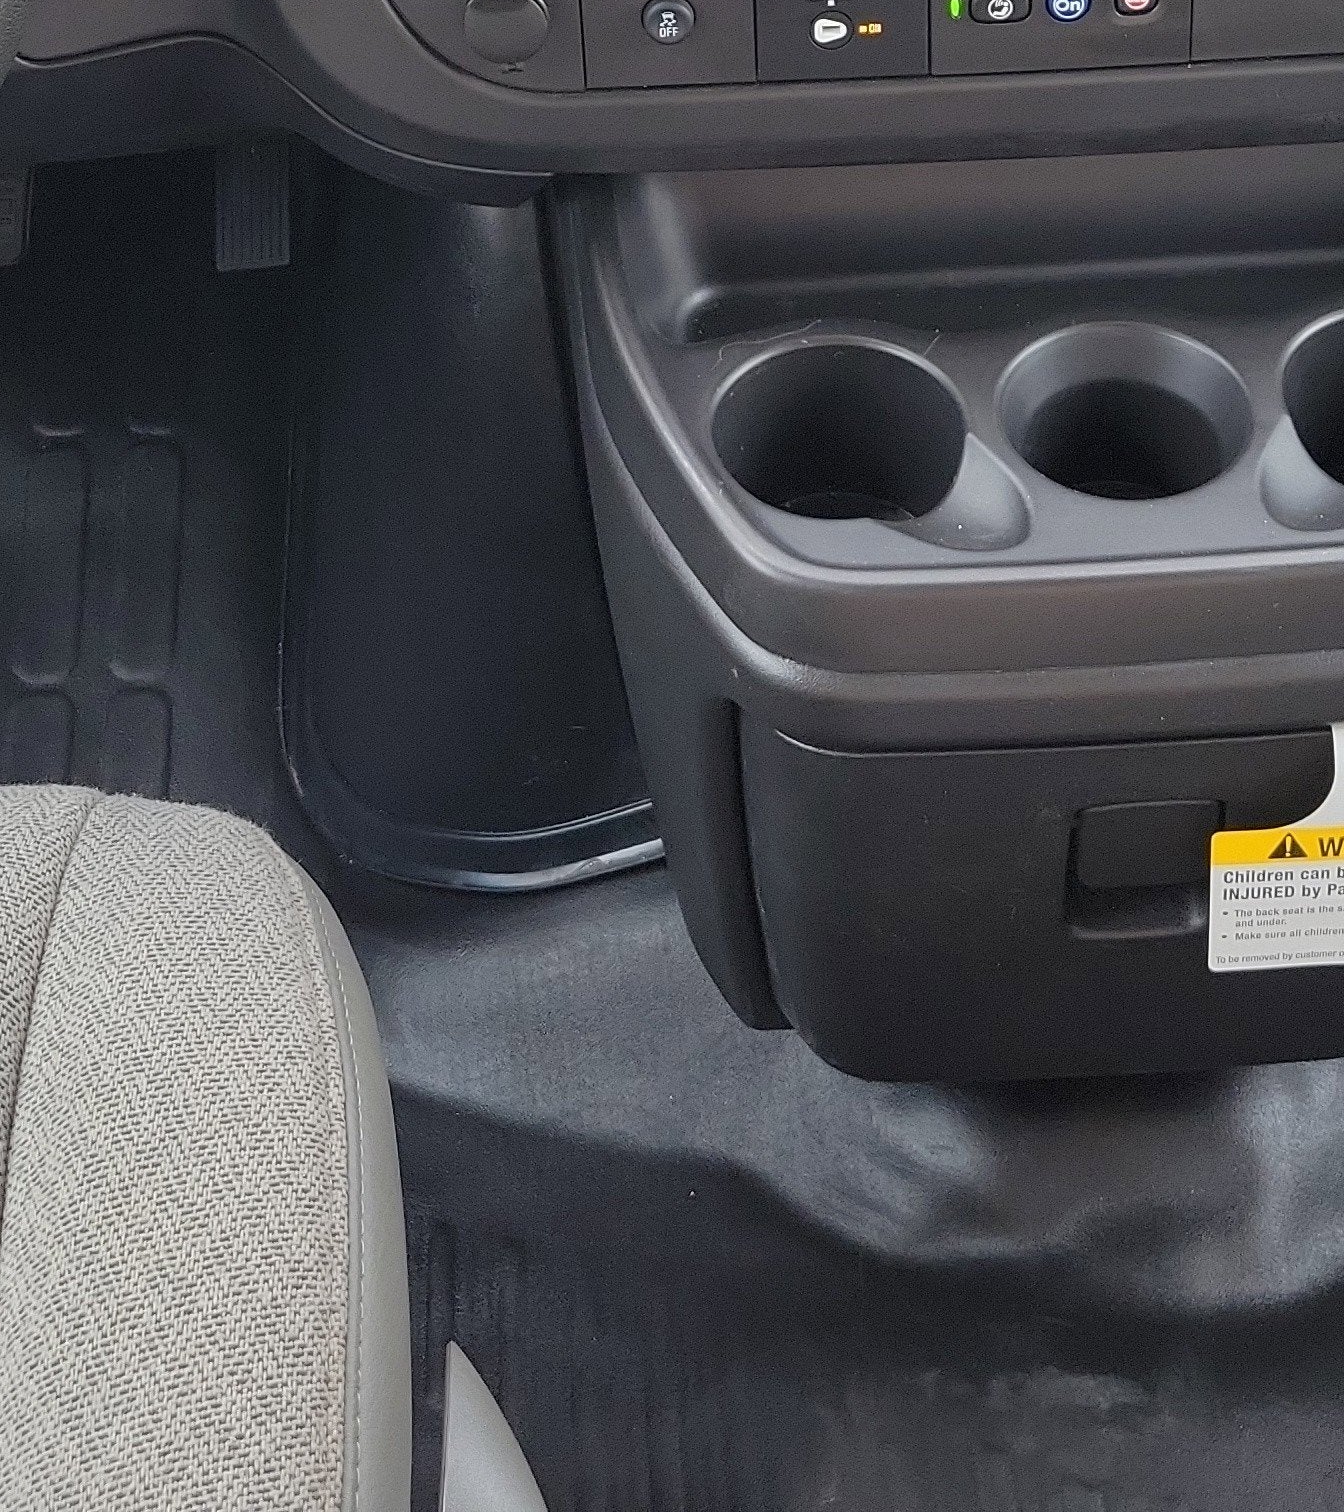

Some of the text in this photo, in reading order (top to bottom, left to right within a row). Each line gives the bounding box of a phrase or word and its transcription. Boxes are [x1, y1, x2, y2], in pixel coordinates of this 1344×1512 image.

[659, 27, 678, 38] OFF
[1224, 870, 1294, 884] Children
[1300, 869, 1330, 880] can
[1223, 885, 1294, 900] INJURED
[1302, 885, 1321, 899] by
[1235, 909, 1252, 918] The
[1256, 907, 1279, 916] back
[1282, 907, 1303, 915] seat
[1307, 906, 1315, 914] is
[1318, 905, 1334, 913] the
[1235, 918, 1287, 928] and under.
[1235, 932, 1261, 941] Make
[1289, 929, 1301, 938] all
[1304, 928, 1344, 937] children
[1216, 956, 1226, 964] To
[1228, 955, 1239, 963] be
[1242, 953, 1280, 962] removed
[1282, 952, 1293, 961] by
[1295, 950, 1336, 959] customer
